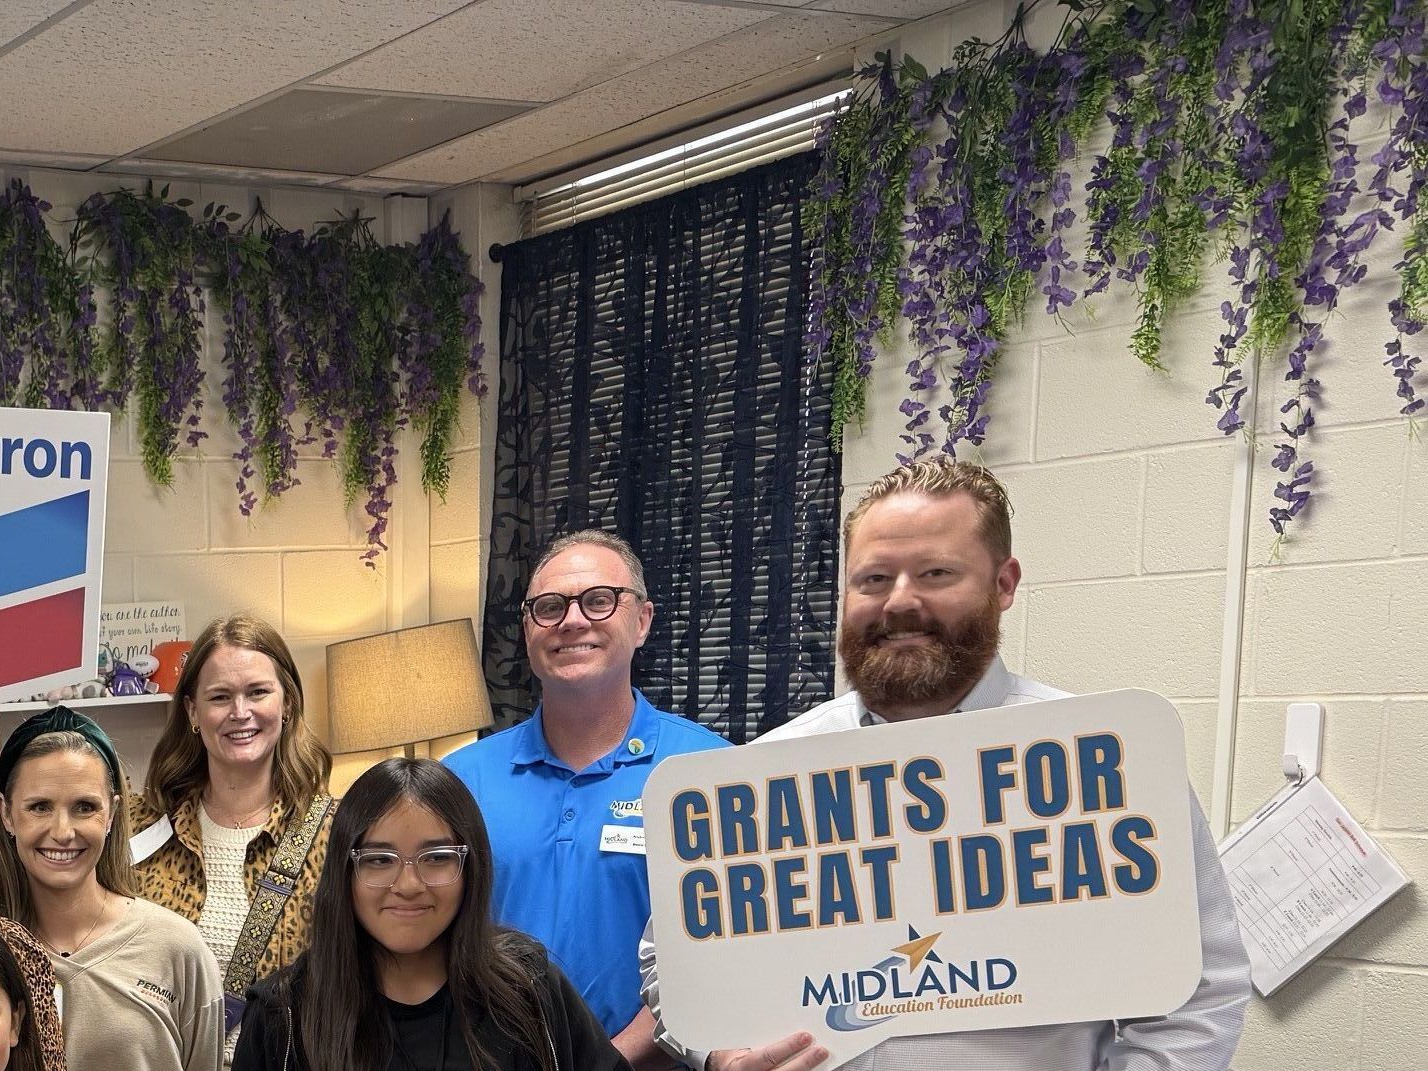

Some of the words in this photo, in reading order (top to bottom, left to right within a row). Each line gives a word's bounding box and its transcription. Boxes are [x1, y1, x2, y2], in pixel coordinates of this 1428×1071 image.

[100, 611, 112, 621] ou
[669, 755, 949, 863] GRANTS
[977, 731, 1128, 827] FOR
[679, 843, 900, 942] GREAT
[929, 814, 1162, 916] IDEAS
[802, 958, 1019, 1007] MIDLAND
[862, 998, 934, 1017] Education
[937, 991, 1023, 1010] Foundation
